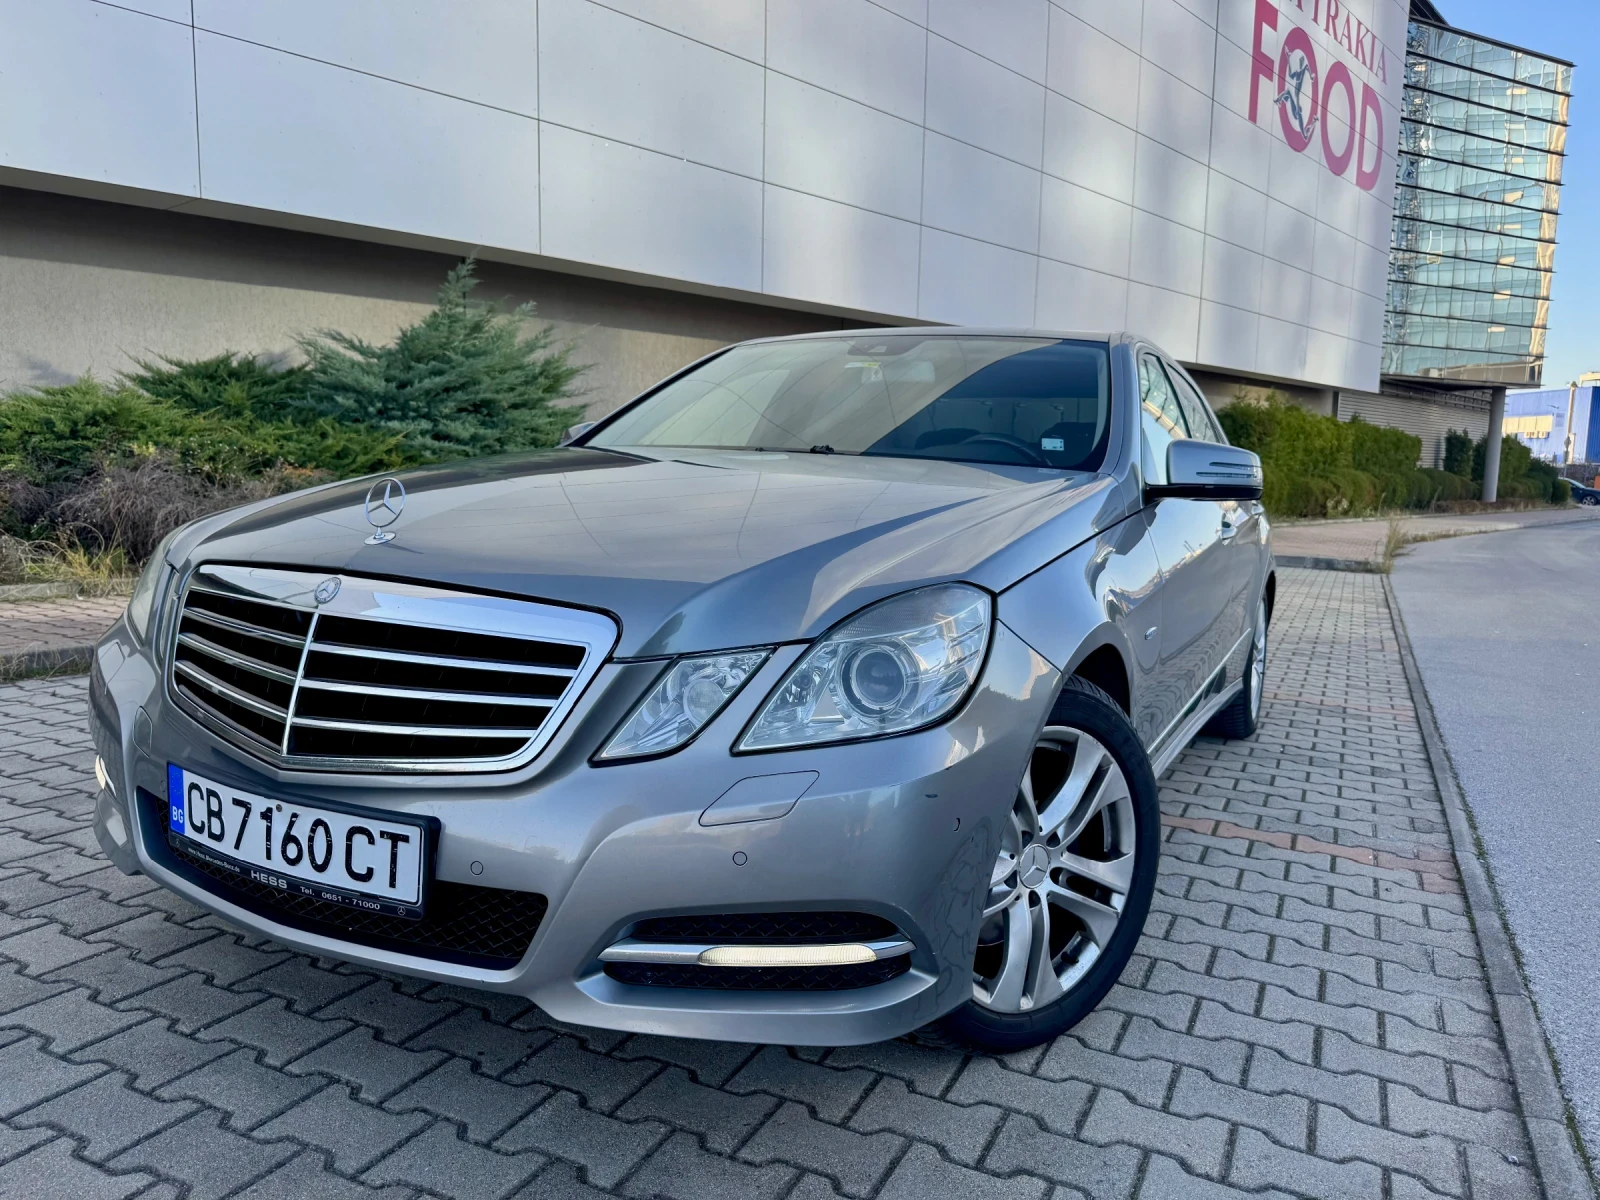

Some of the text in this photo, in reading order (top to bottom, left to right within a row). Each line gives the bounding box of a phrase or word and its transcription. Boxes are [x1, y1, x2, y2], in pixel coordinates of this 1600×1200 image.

[1248, 0, 1383, 191] FOOD
[172, 806, 184, 823] BG
[250, 870, 287, 889] HESS
[300, 886, 315, 896] Tel.
[321, 891, 342, 902] 0651
[352, 898, 380, 910] 71000
